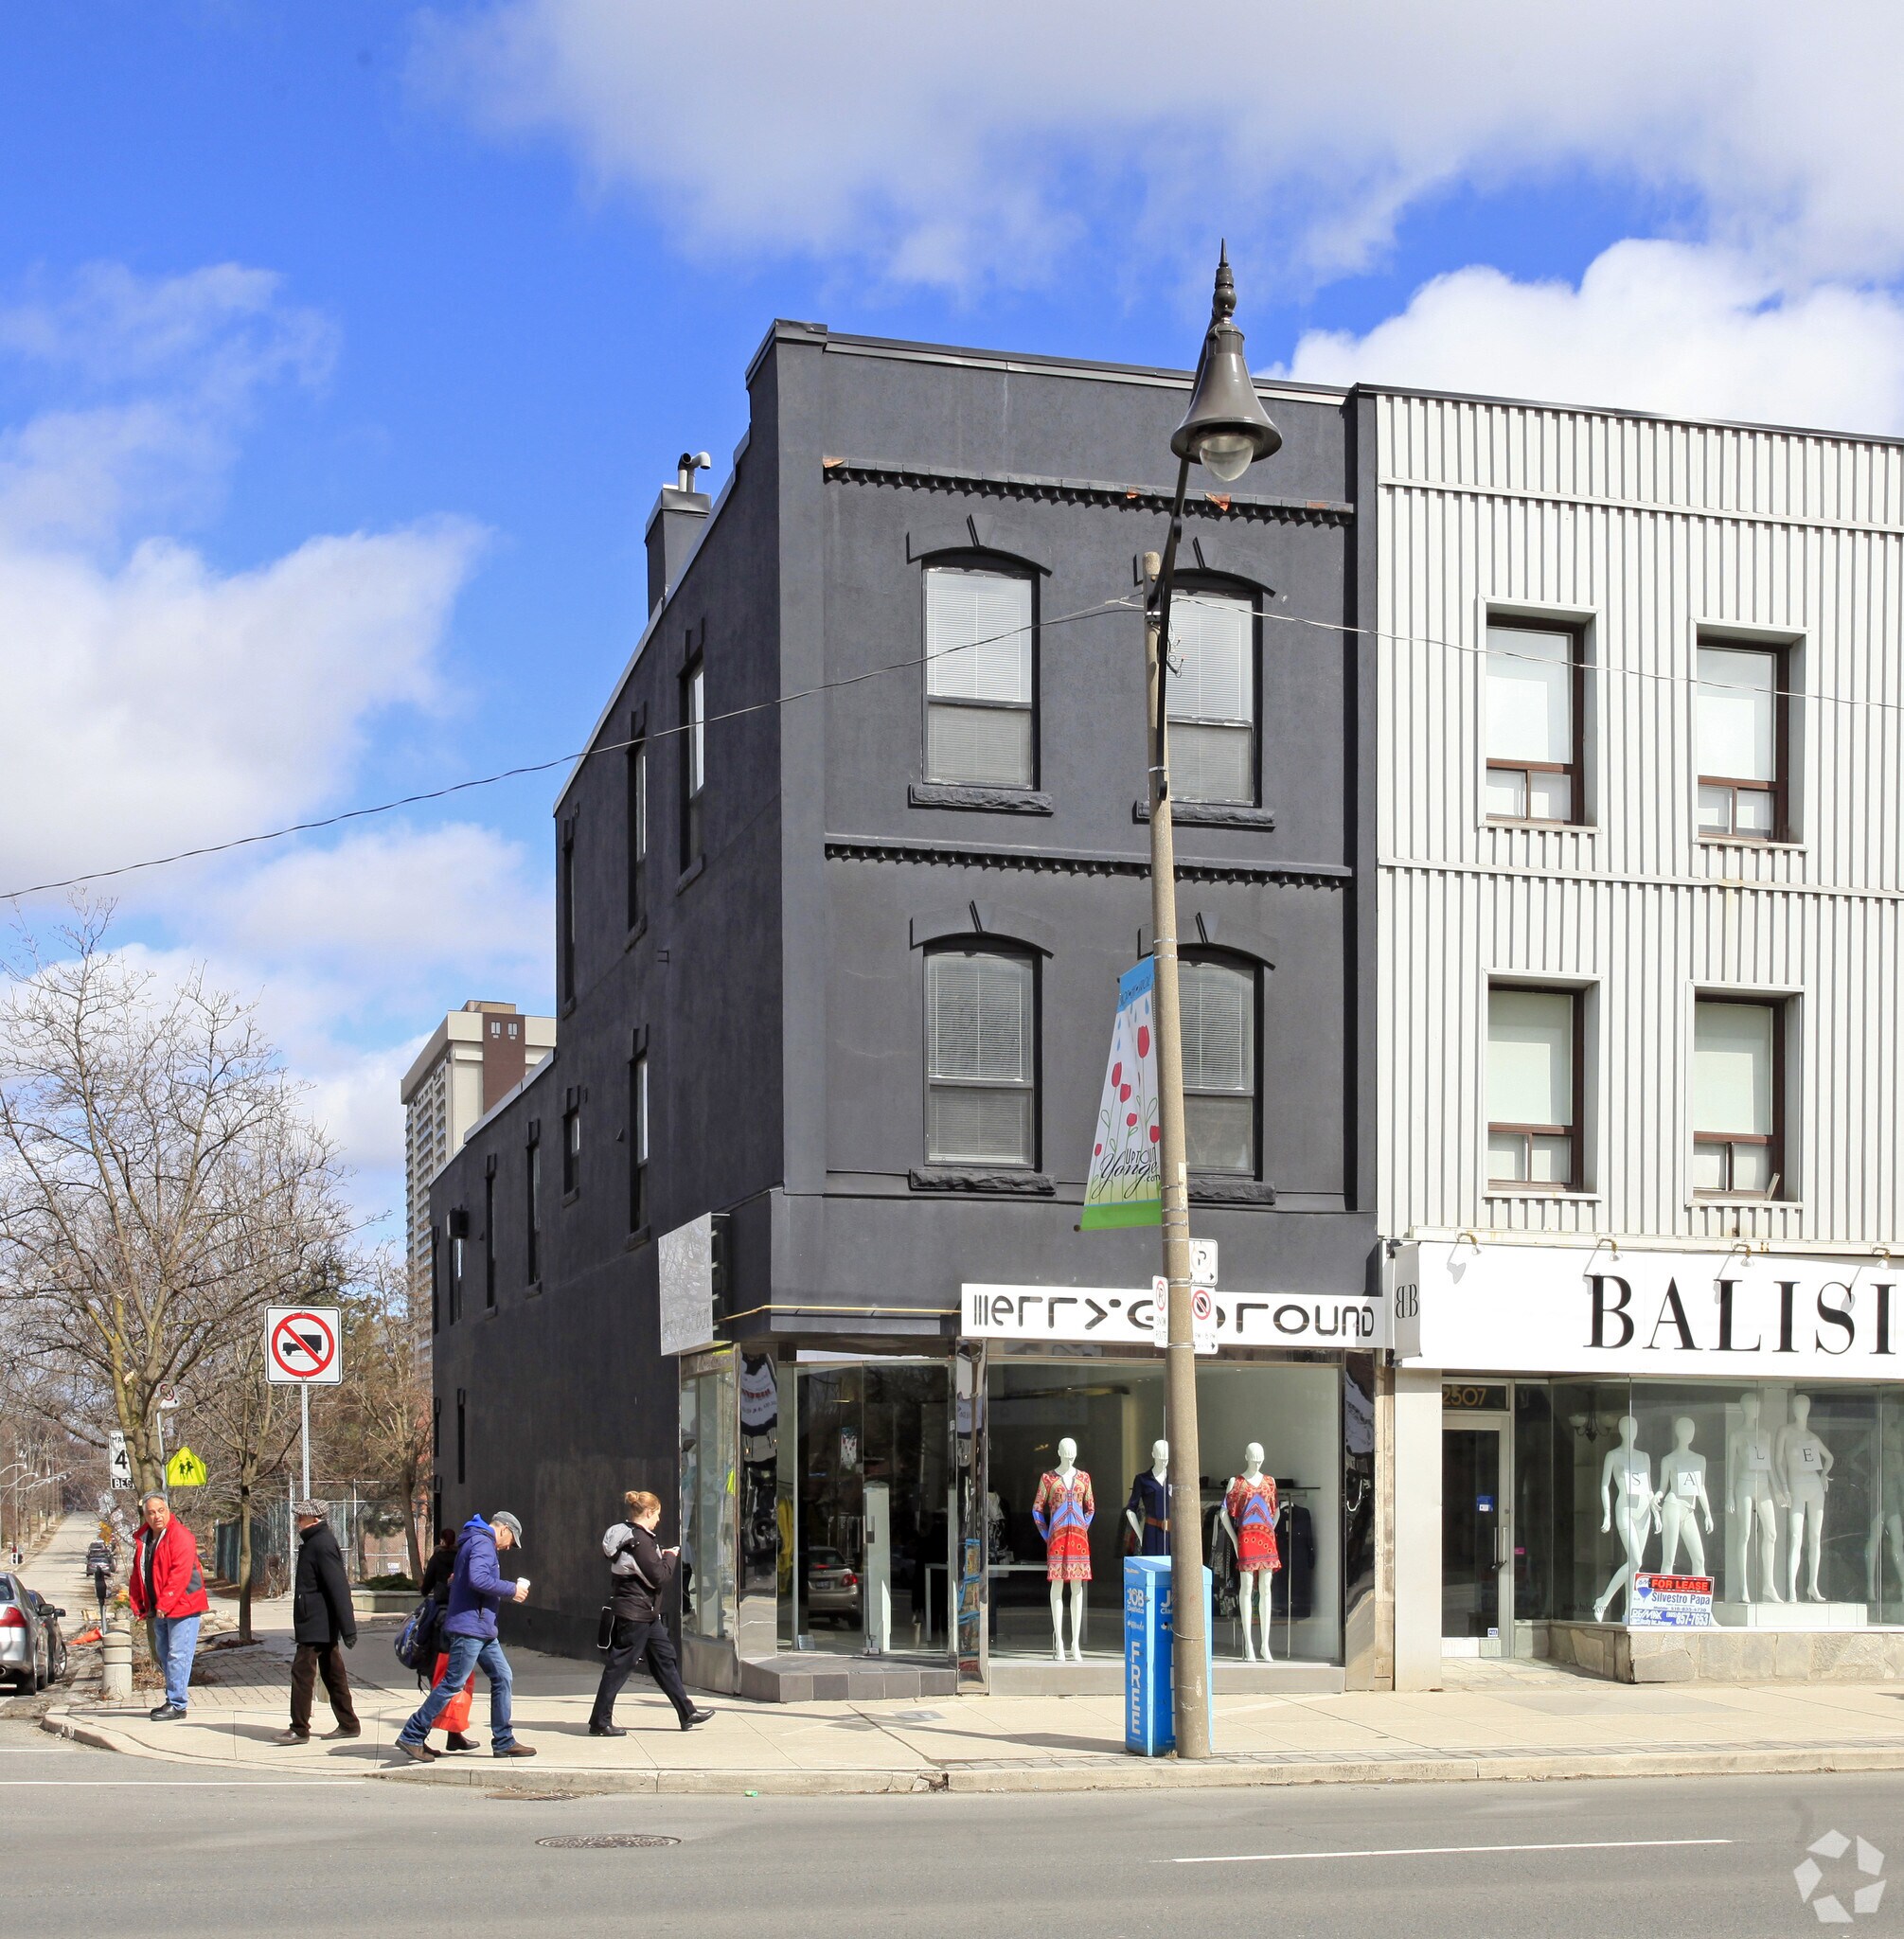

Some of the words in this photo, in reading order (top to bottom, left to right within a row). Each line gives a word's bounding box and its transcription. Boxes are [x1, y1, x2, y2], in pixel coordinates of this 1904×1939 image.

[1091, 1150, 1158, 1200] Yonge
[1583, 1274, 1897, 1355] BALISI
[1442, 1386, 1486, 1406] 2507
[115, 1450, 128, 1469] 4
[1651, 1579, 1673, 1590] FOR
[1675, 1580, 1709, 1592] LEASE
[1651, 1592, 1688, 1605] Silvestro
[1690, 1594, 1711, 1607] Papa
